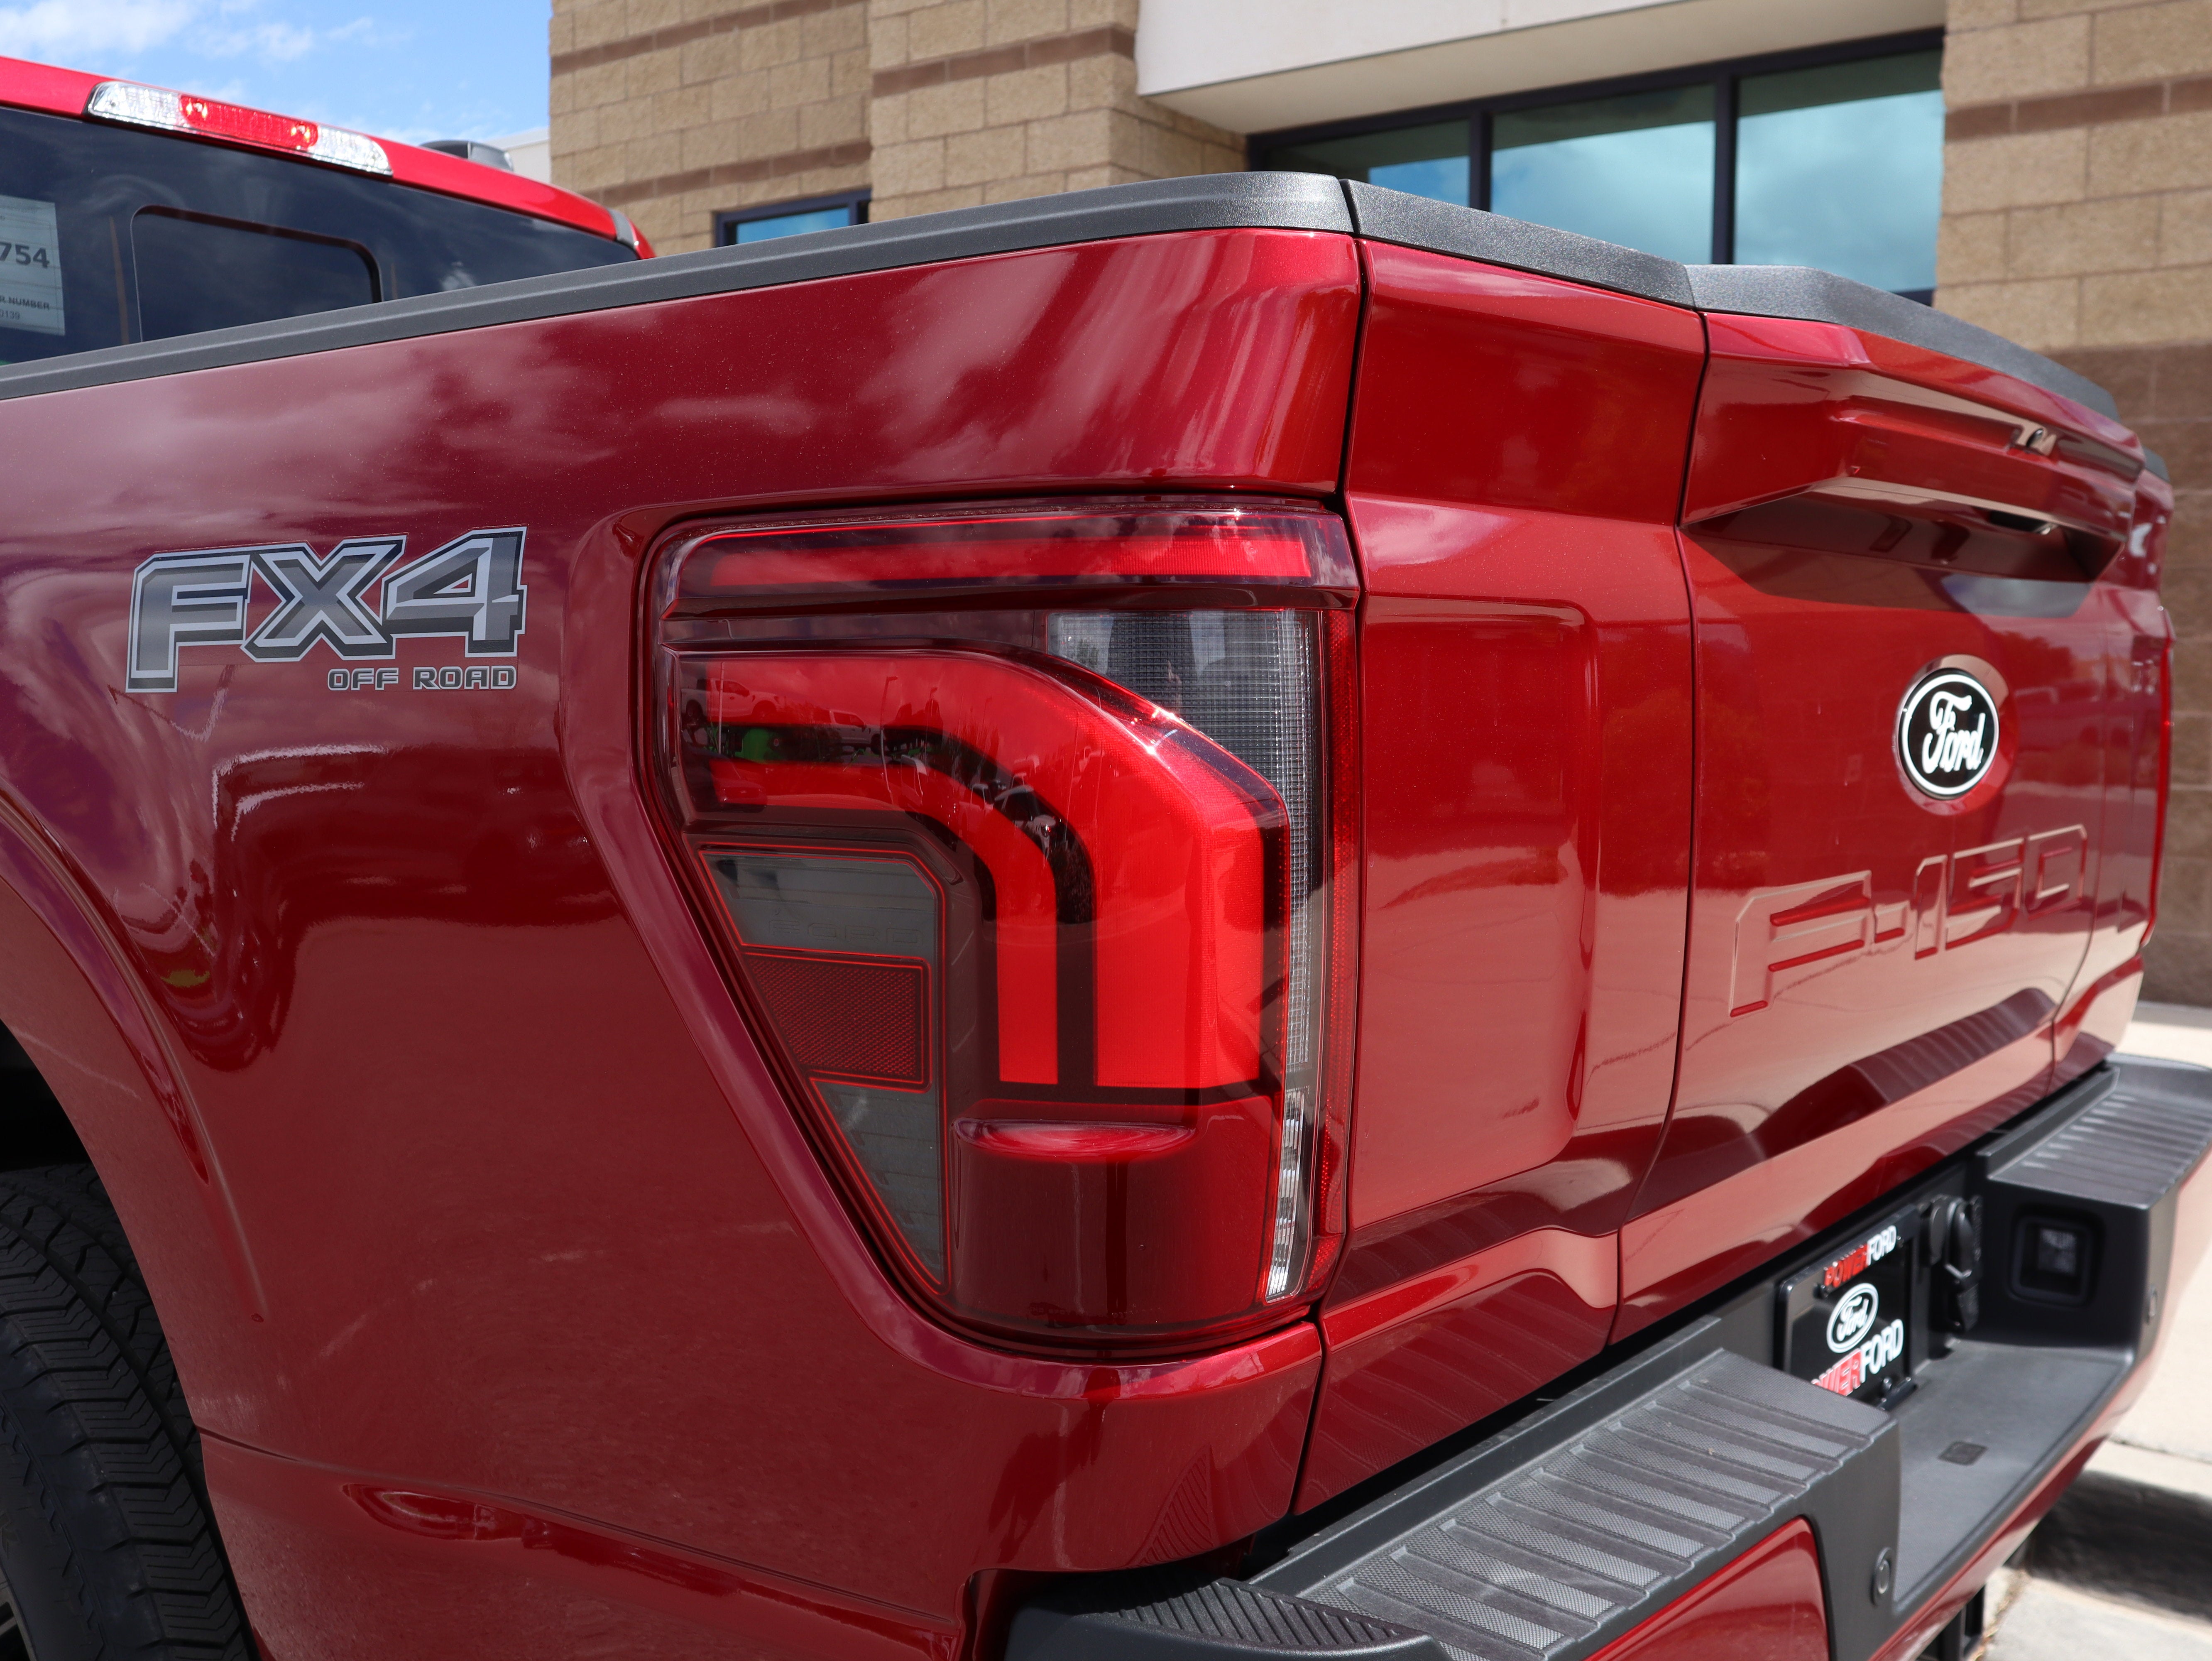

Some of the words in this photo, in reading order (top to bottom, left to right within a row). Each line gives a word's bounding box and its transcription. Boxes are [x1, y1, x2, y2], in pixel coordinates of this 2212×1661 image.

[8, 296, 49, 310] NUMBER
[125, 525, 528, 693] FX4
[327, 667, 399, 691] OFF
[412, 665, 517, 691] ROAD
[1921, 691, 1986, 774] Ford
[1730, 823, 2088, 1018] F-150
[1836, 1296, 1869, 1342] Ford
